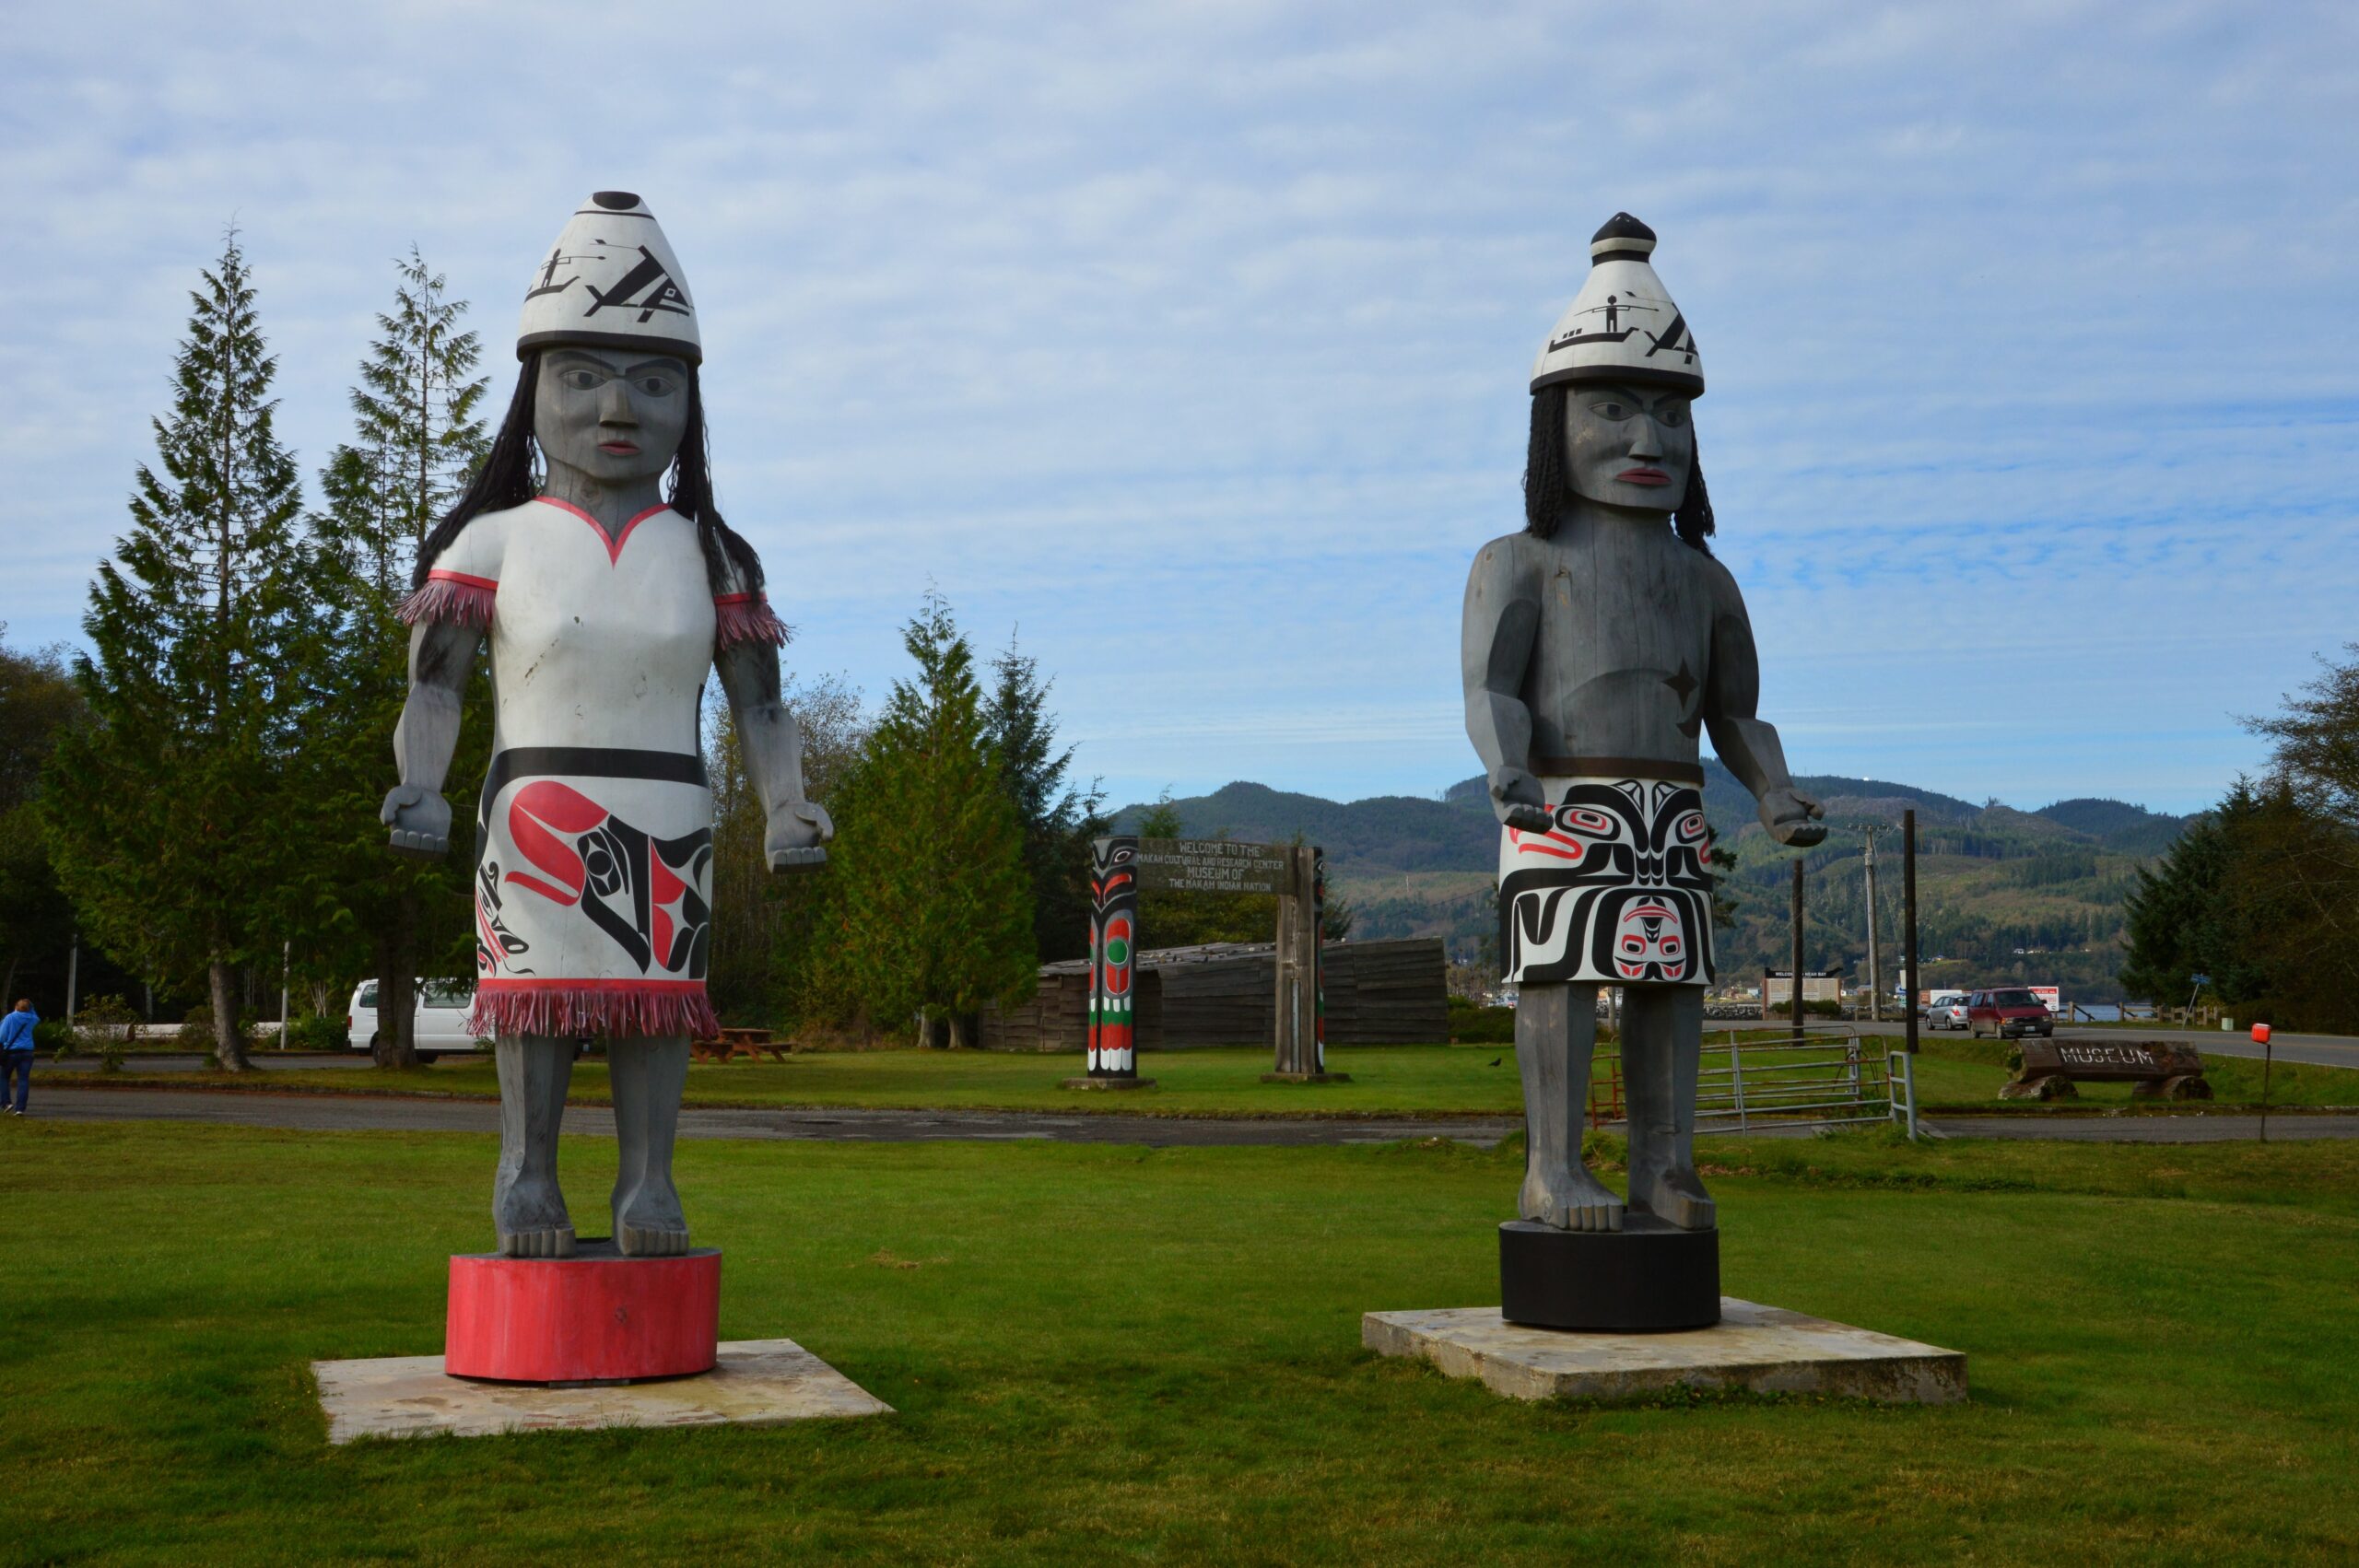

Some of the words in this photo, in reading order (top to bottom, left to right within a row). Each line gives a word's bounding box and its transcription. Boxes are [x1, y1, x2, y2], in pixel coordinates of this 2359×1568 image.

[1180, 842, 1224, 855] WELCOME
[1225, 843, 1238, 855] TO
[1239, 845, 1261, 858] THE
[1136, 853, 1163, 864] MAKAH
[1164, 854, 1202, 866] CULTURAL
[1202, 857, 1216, 866] AND
[1216, 858, 1251, 869] RESEARCH
[1253, 860, 1285, 871] CENTER
[1187, 867, 1229, 880] MUSEUM
[1231, 869, 1245, 881] OF
[1169, 878, 1186, 888] THE
[1186, 879, 1215, 891] MAKAH
[1217, 881, 1241, 891] INDIAN
[1243, 882, 1272, 893] NATION
[2060, 1047, 2154, 1066] MUSEUM
